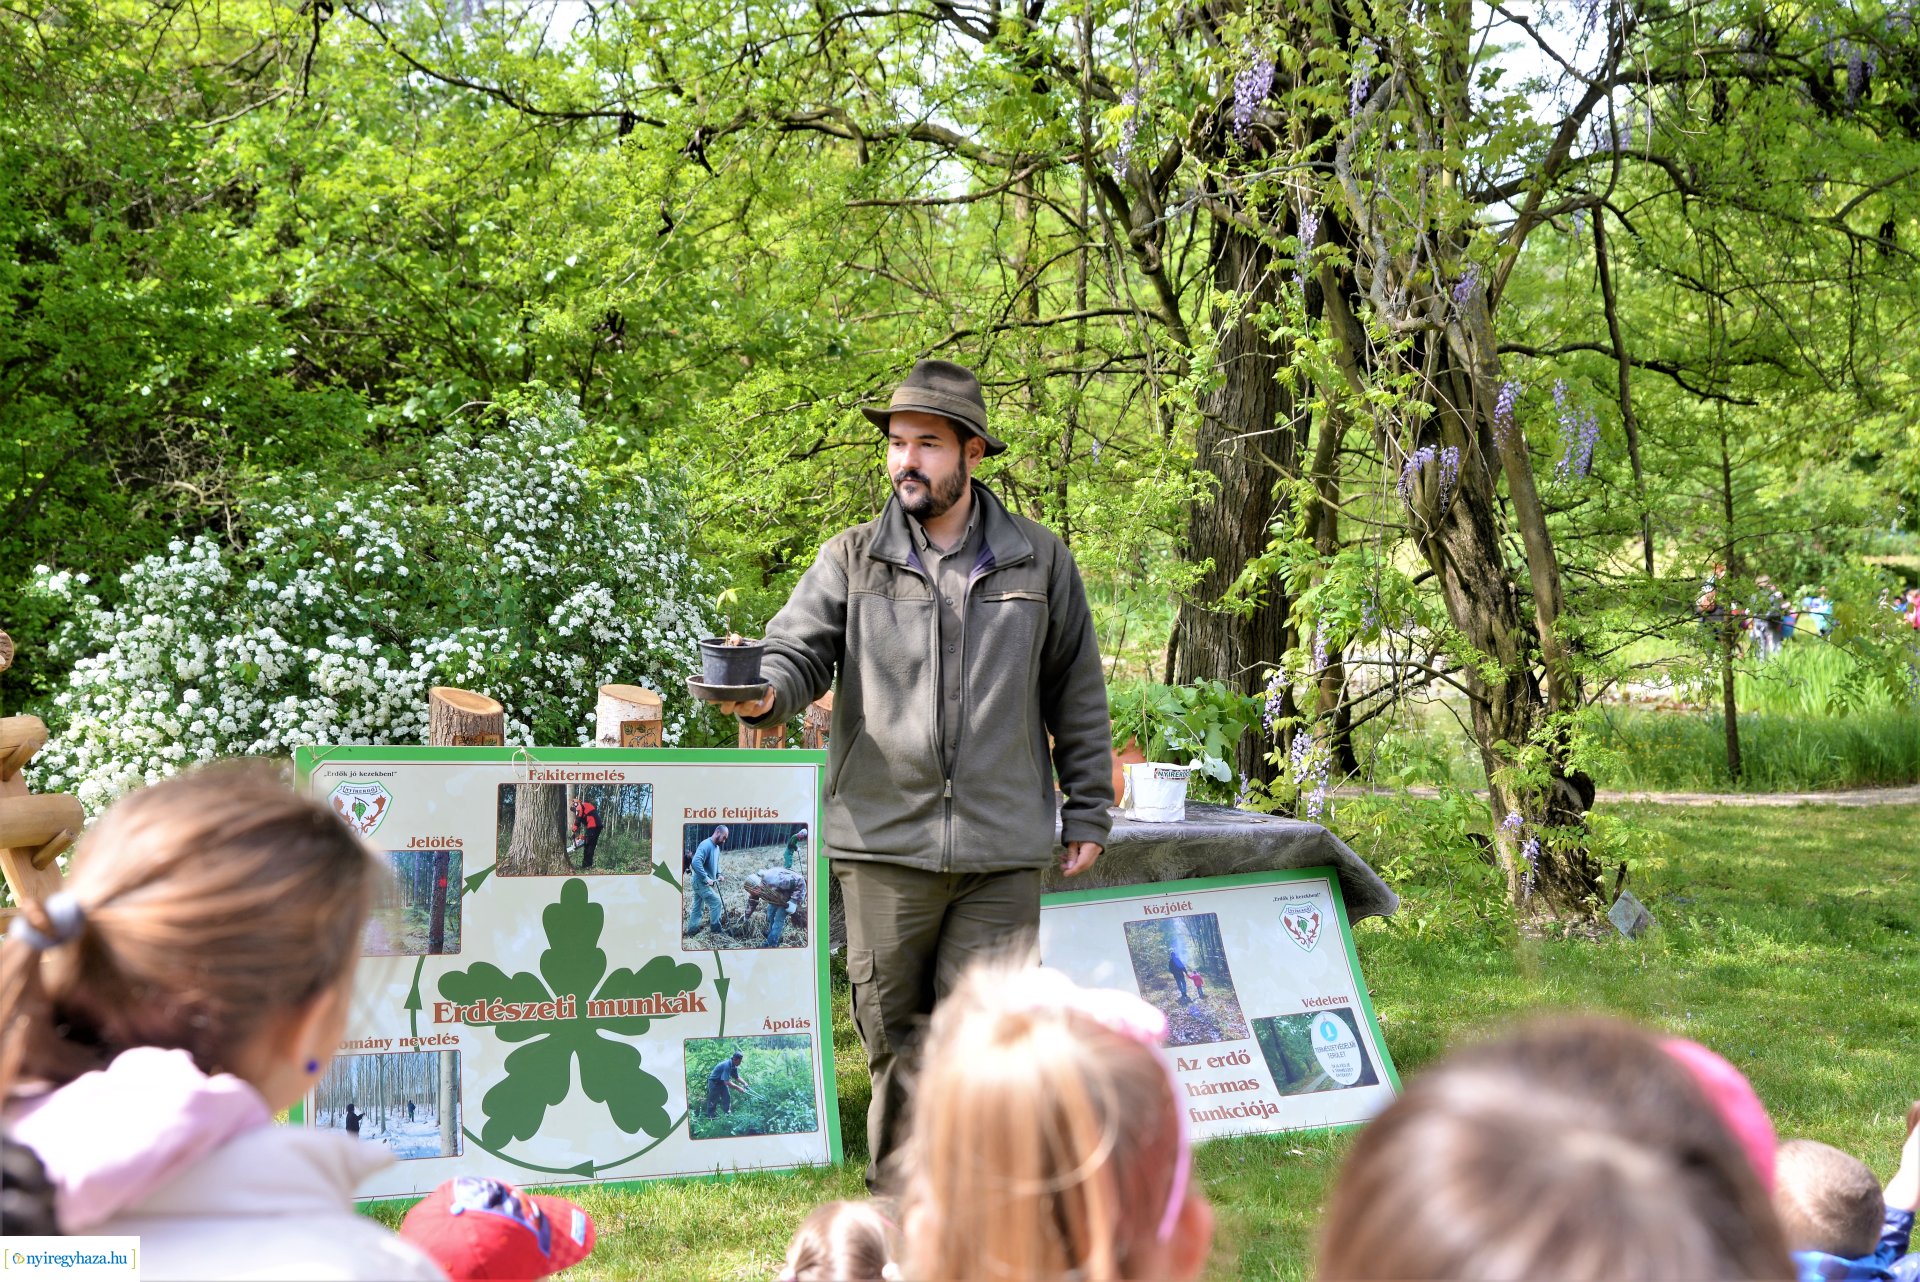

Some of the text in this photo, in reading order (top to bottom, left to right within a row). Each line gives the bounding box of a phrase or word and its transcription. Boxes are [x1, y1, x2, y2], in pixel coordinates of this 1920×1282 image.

[528, 768, 626, 781] Fakitermelés
[683, 806, 779, 821] Erdő felújítás
[406, 836, 463, 848] Jelölés
[1143, 900, 1194, 916] Közjólét
[433, 990, 708, 1024] Erdészeti munkák
[1302, 995, 1349, 1007] Védelem
[762, 1015, 811, 1033] Ápolás
[399, 1032, 460, 1047] nevelés
[1177, 1048, 1251, 1071] Az erdő
[1184, 1078, 1260, 1097] hármas
[1188, 1099, 1281, 1123] funkciója
